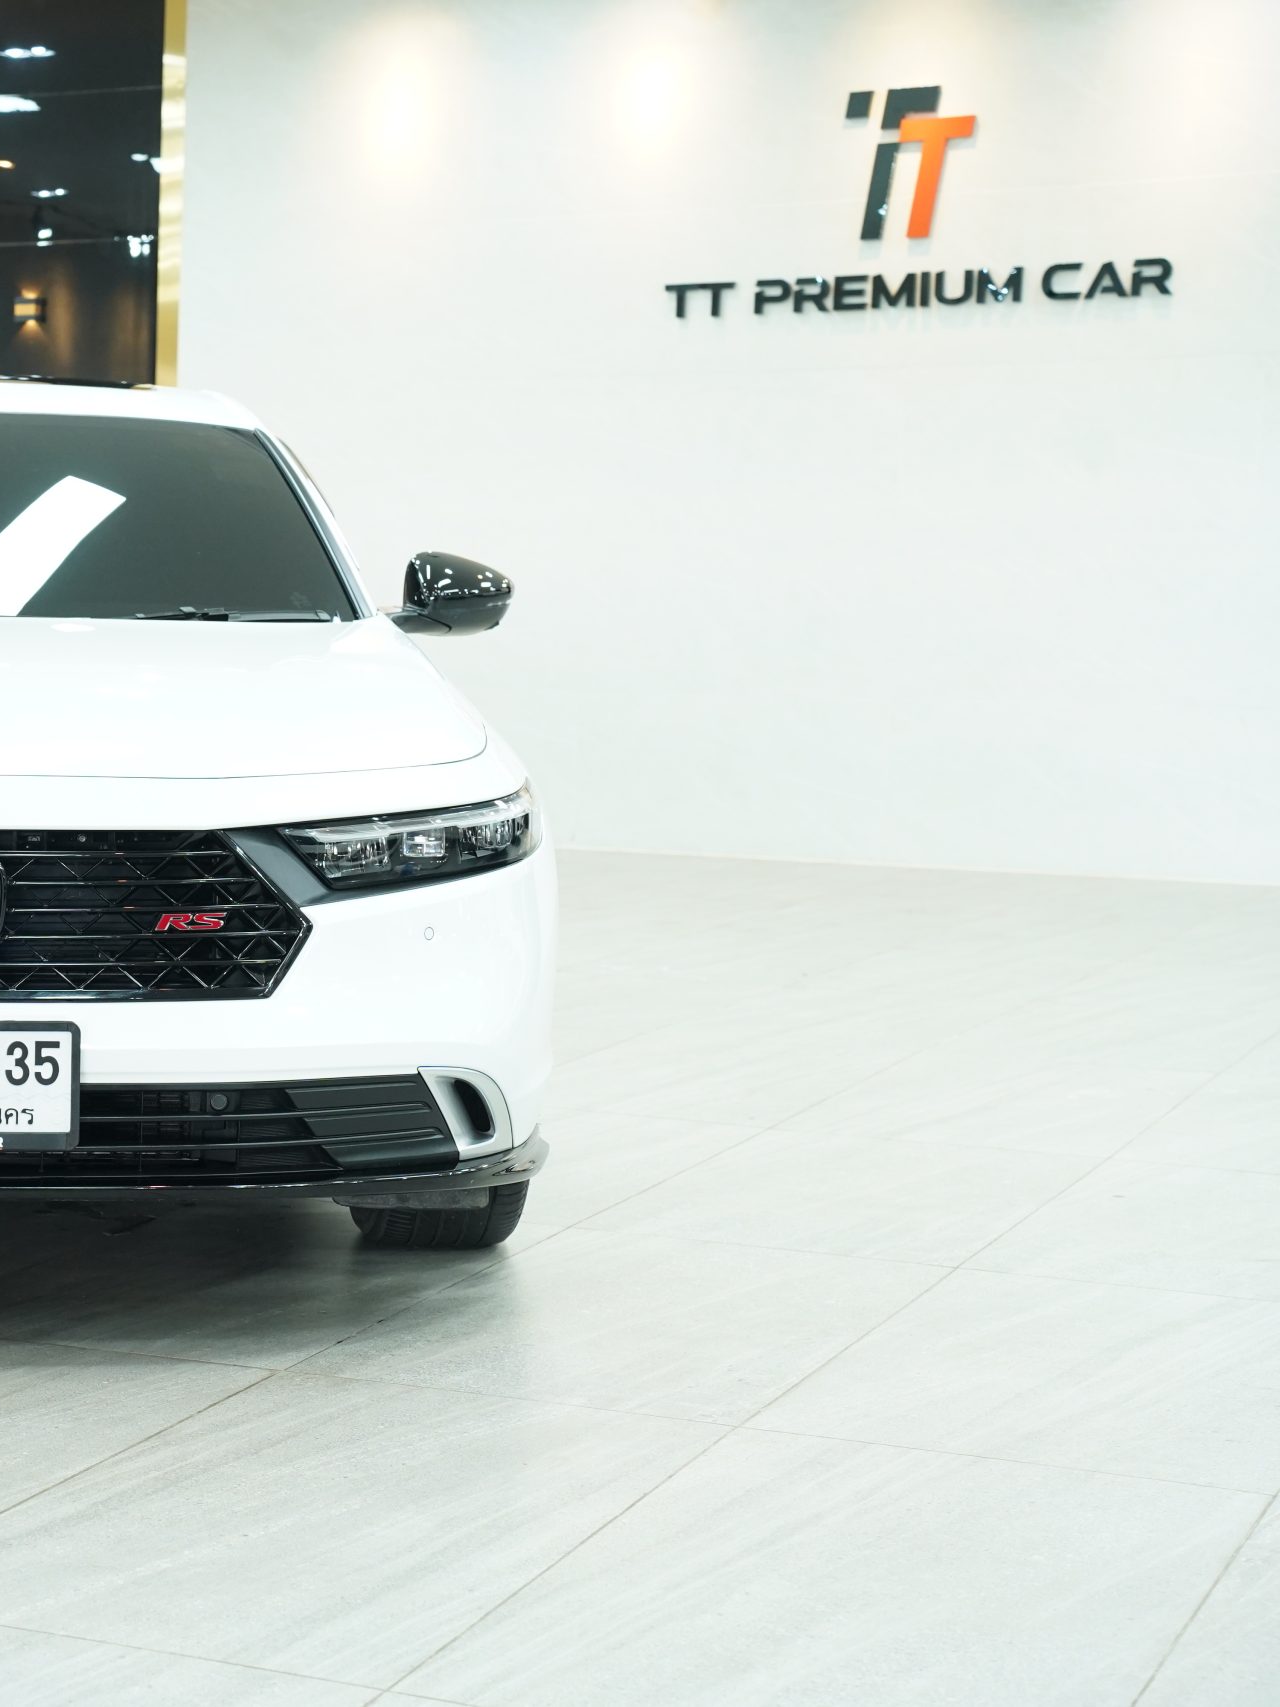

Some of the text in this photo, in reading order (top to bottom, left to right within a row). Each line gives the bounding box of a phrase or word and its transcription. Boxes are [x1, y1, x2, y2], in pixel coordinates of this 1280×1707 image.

[665, 258, 1173, 318] TT PREMIUM CAR
[154, 912, 227, 932] RS
